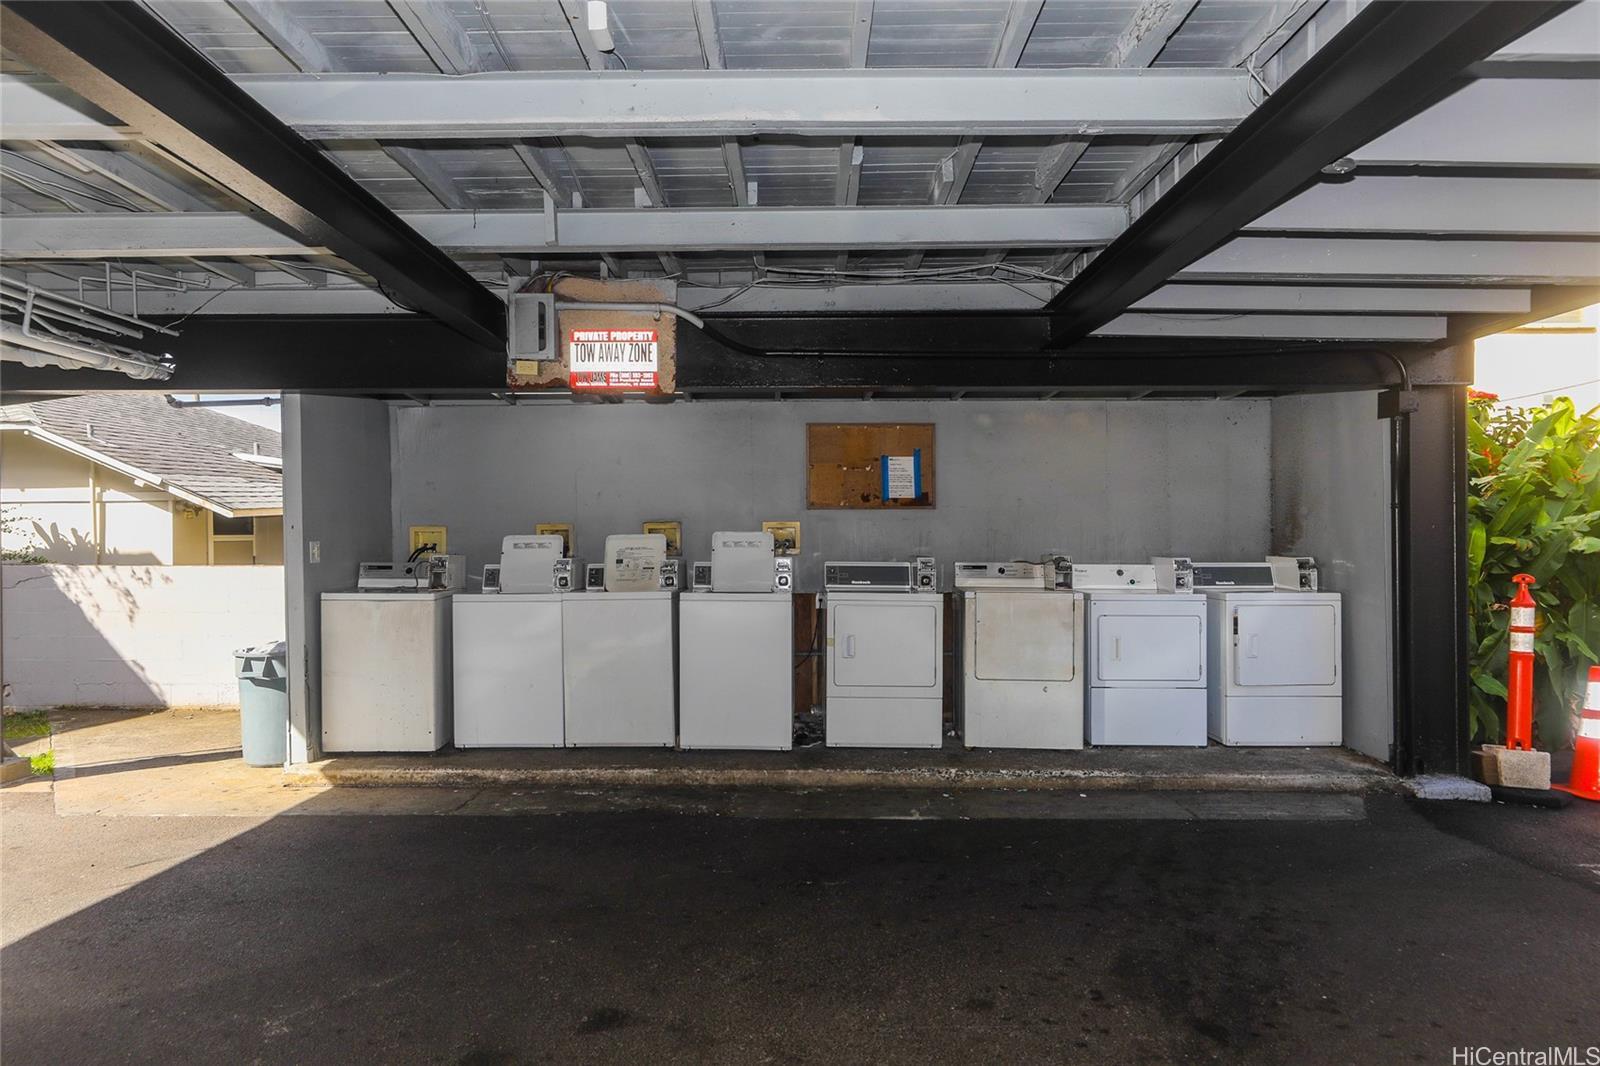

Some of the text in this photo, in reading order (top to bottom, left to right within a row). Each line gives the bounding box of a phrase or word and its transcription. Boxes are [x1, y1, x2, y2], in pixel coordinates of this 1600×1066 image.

[573, 331, 654, 341] PRIVATE PROPERTY
[575, 343, 653, 362] TOW AWAY ZONE
